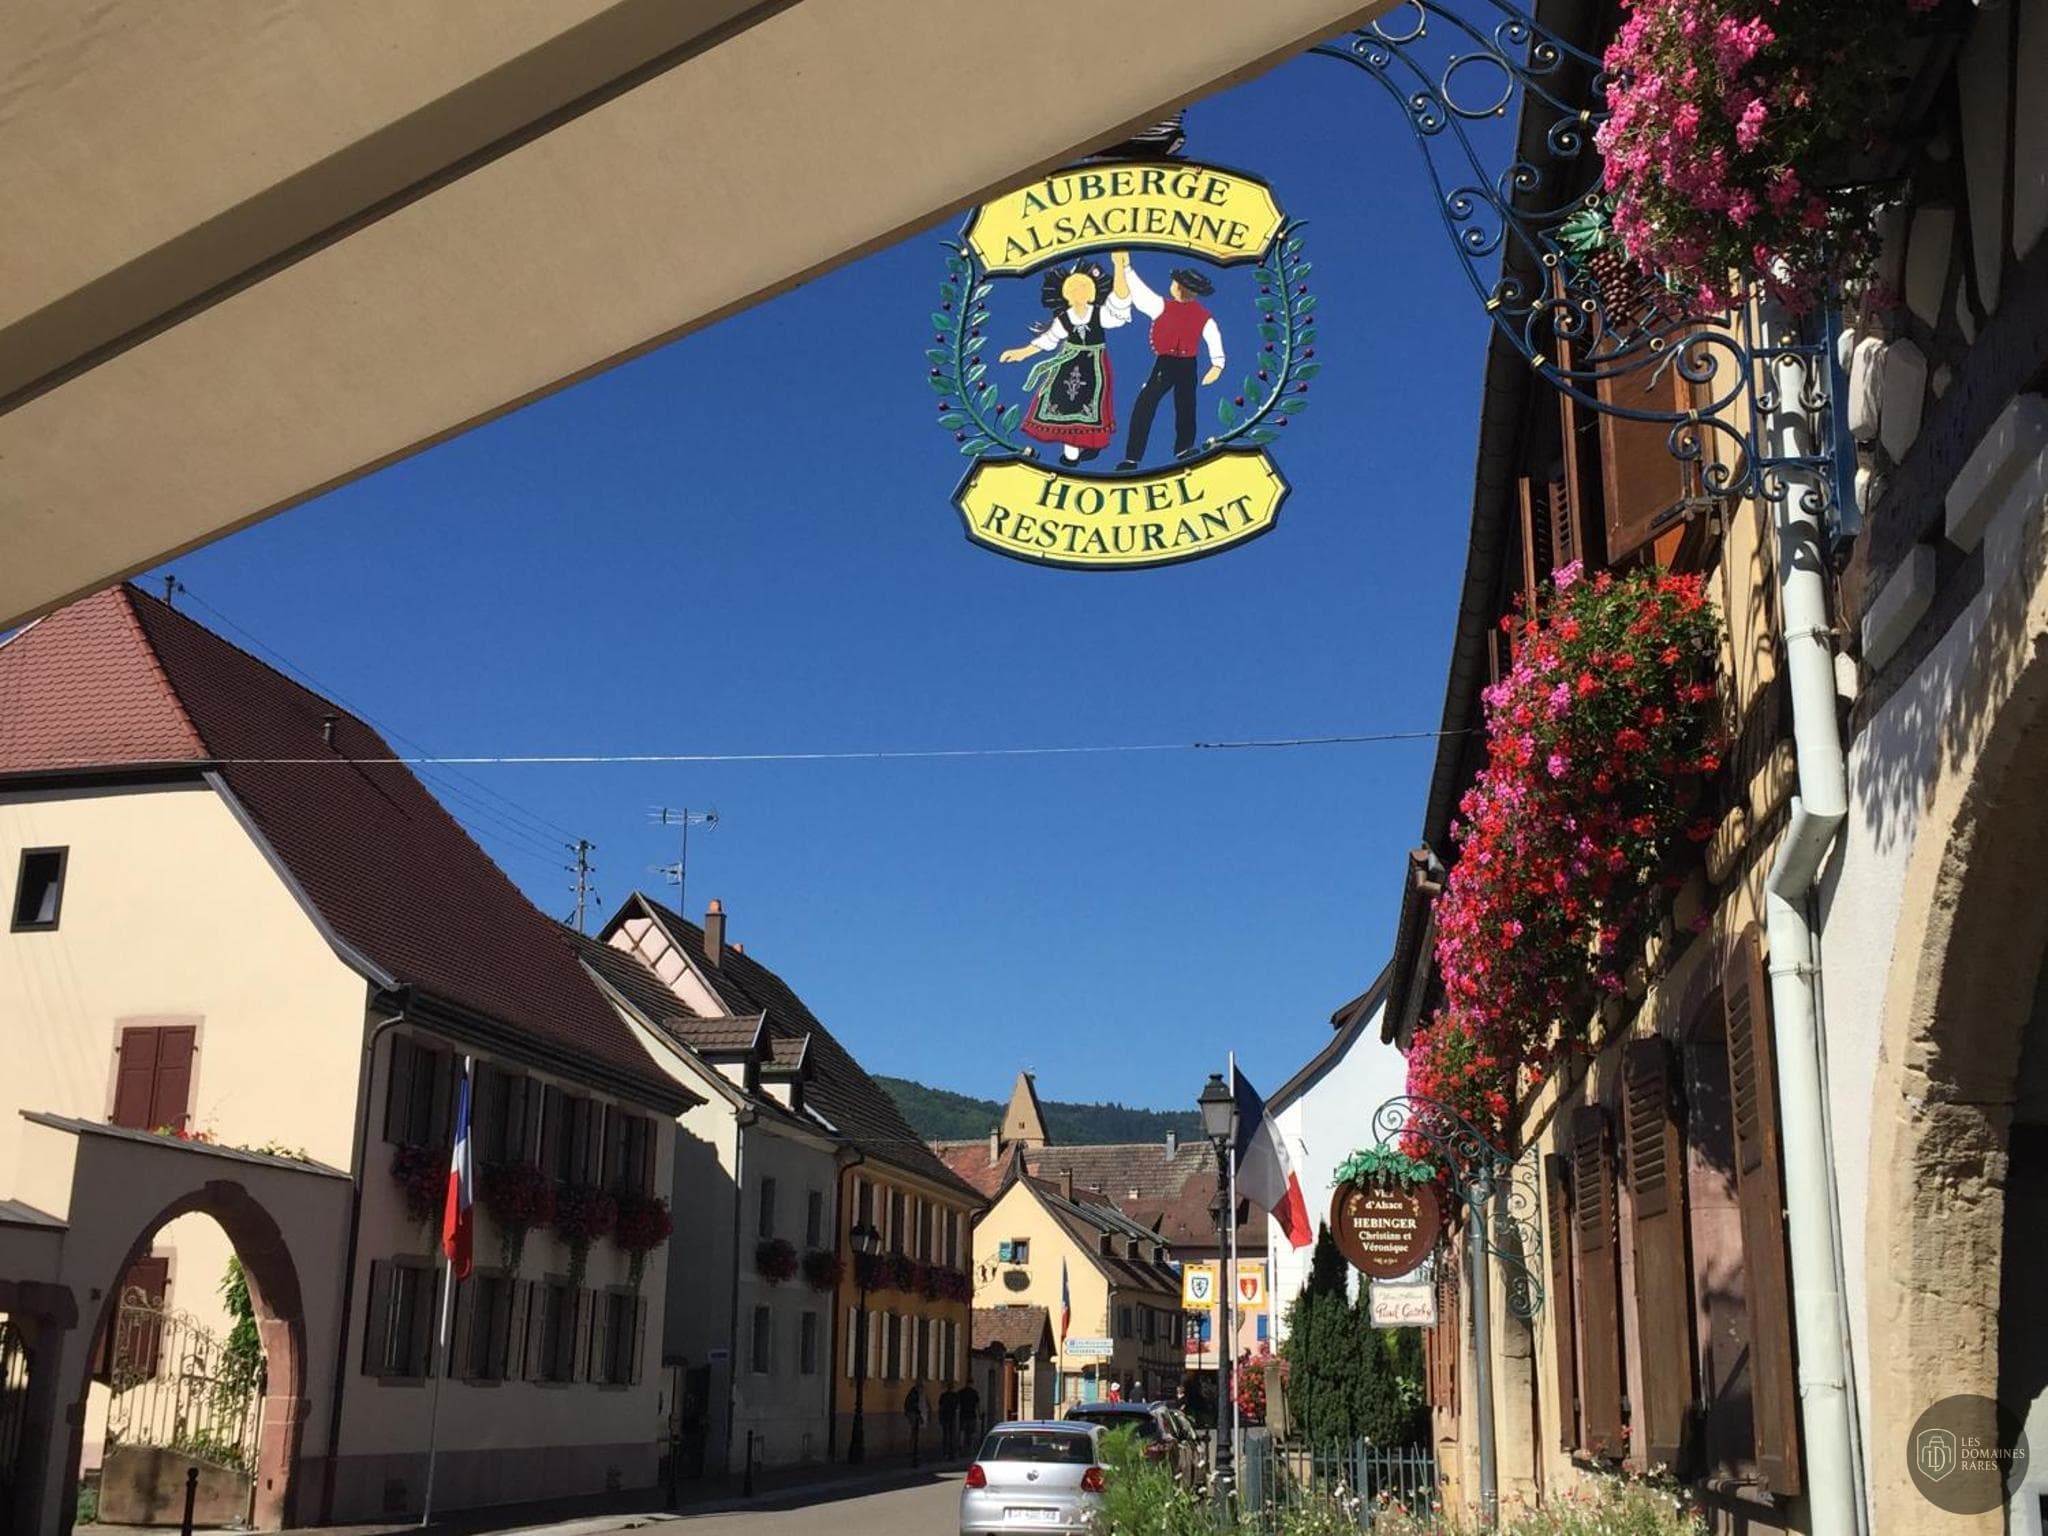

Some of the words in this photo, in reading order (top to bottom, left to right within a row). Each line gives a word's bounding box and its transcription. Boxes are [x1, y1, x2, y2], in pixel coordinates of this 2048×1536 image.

[1021, 169, 1231, 219] AUBERGE
[1003, 207, 1250, 263] ALSACIENNE
[1035, 477, 1205, 516] HOTEL
[980, 494, 1256, 554] RESTAURANT
[1365, 1200, 1403, 1210] d'Alsace
[1353, 1217, 1417, 1229] HEBINGER
[1358, 1230, 1401, 1241] Christian
[1402, 1231, 1413, 1241] et
[1362, 1241, 1409, 1254] Véronique
